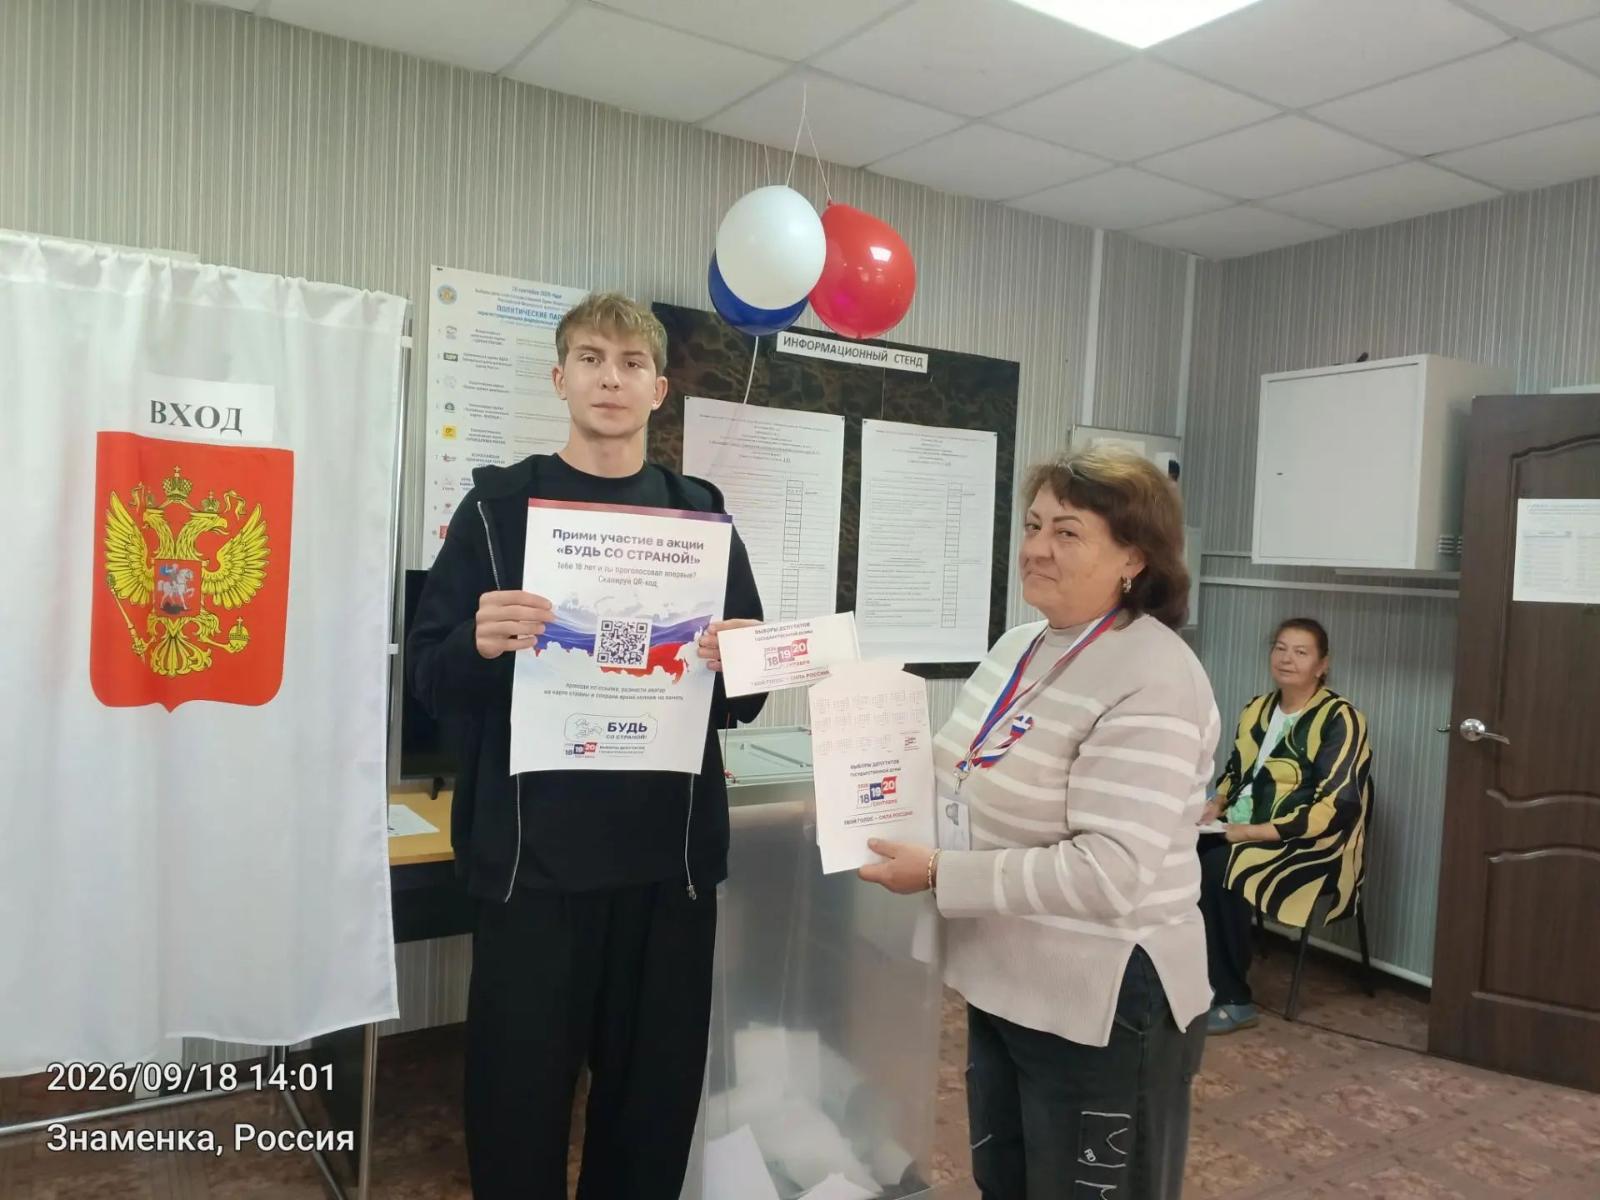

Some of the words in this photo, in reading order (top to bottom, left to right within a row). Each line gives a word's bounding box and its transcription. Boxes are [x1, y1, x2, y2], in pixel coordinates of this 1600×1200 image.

[497, 305, 547, 319] ПОЛИТИЧЕСКИЕ
[783, 336, 888, 362] ИНФОРМАЦИОННЫЙ
[894, 354, 923, 368] СТЕНД
[150, 400, 243, 437] ВХОД
[552, 529, 597, 540] Прими
[600, 534, 654, 546] участие
[656, 537, 664, 547] в
[666, 539, 704, 551] акции
[556, 545, 601, 558] «БУДЬ
[604, 548, 624, 559] СО
[626, 549, 701, 565] СТРАНОЙ!»
[767, 656, 779, 667] 18
[779, 649, 792, 660] 19
[792, 642, 807, 653] 20
[607, 722, 648, 734] БУДЬ
[860, 793, 870, 804] 18
[882, 780, 895, 791] 20
